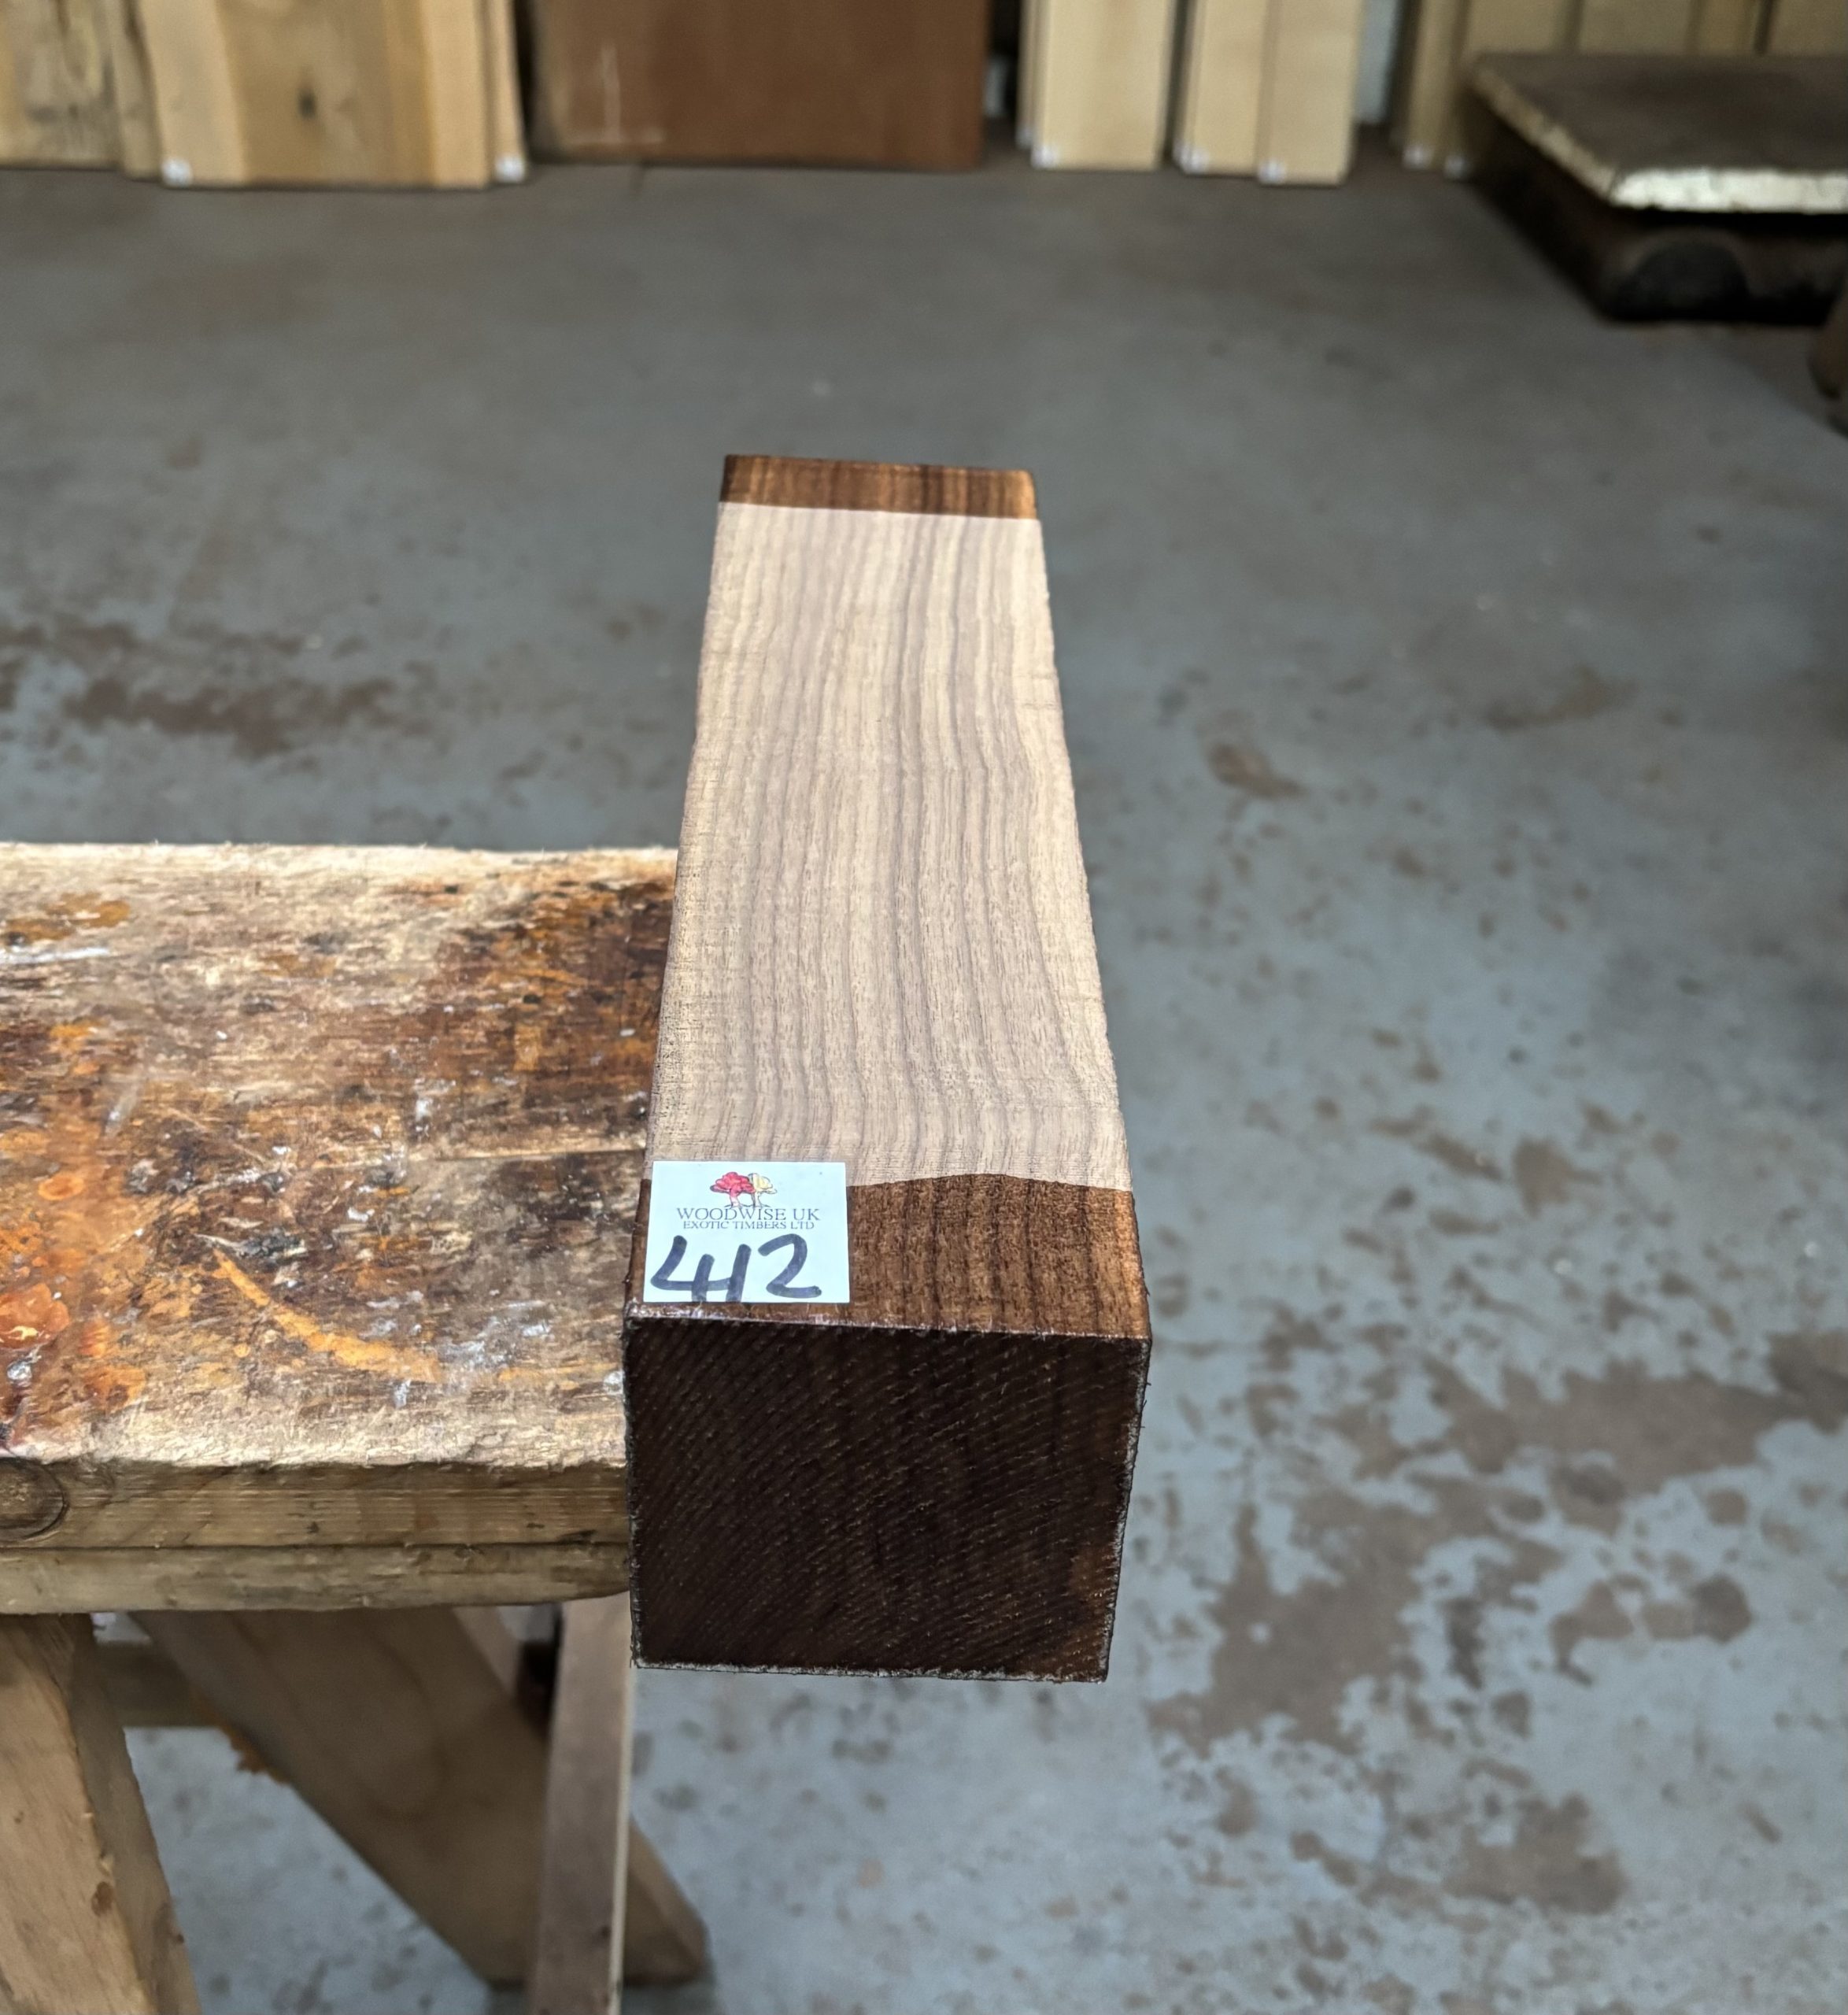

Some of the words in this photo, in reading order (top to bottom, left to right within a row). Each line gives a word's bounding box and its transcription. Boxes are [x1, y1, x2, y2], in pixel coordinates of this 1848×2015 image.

[676, 1207, 786, 1221] WOODWISE
[793, 1207, 821, 1221] UK
[682, 1220, 730, 1229] EXOTIC
[732, 1221, 787, 1229] TIMBERS
[790, 1221, 815, 1229] LTD
[650, 1233, 822, 1303] 412
